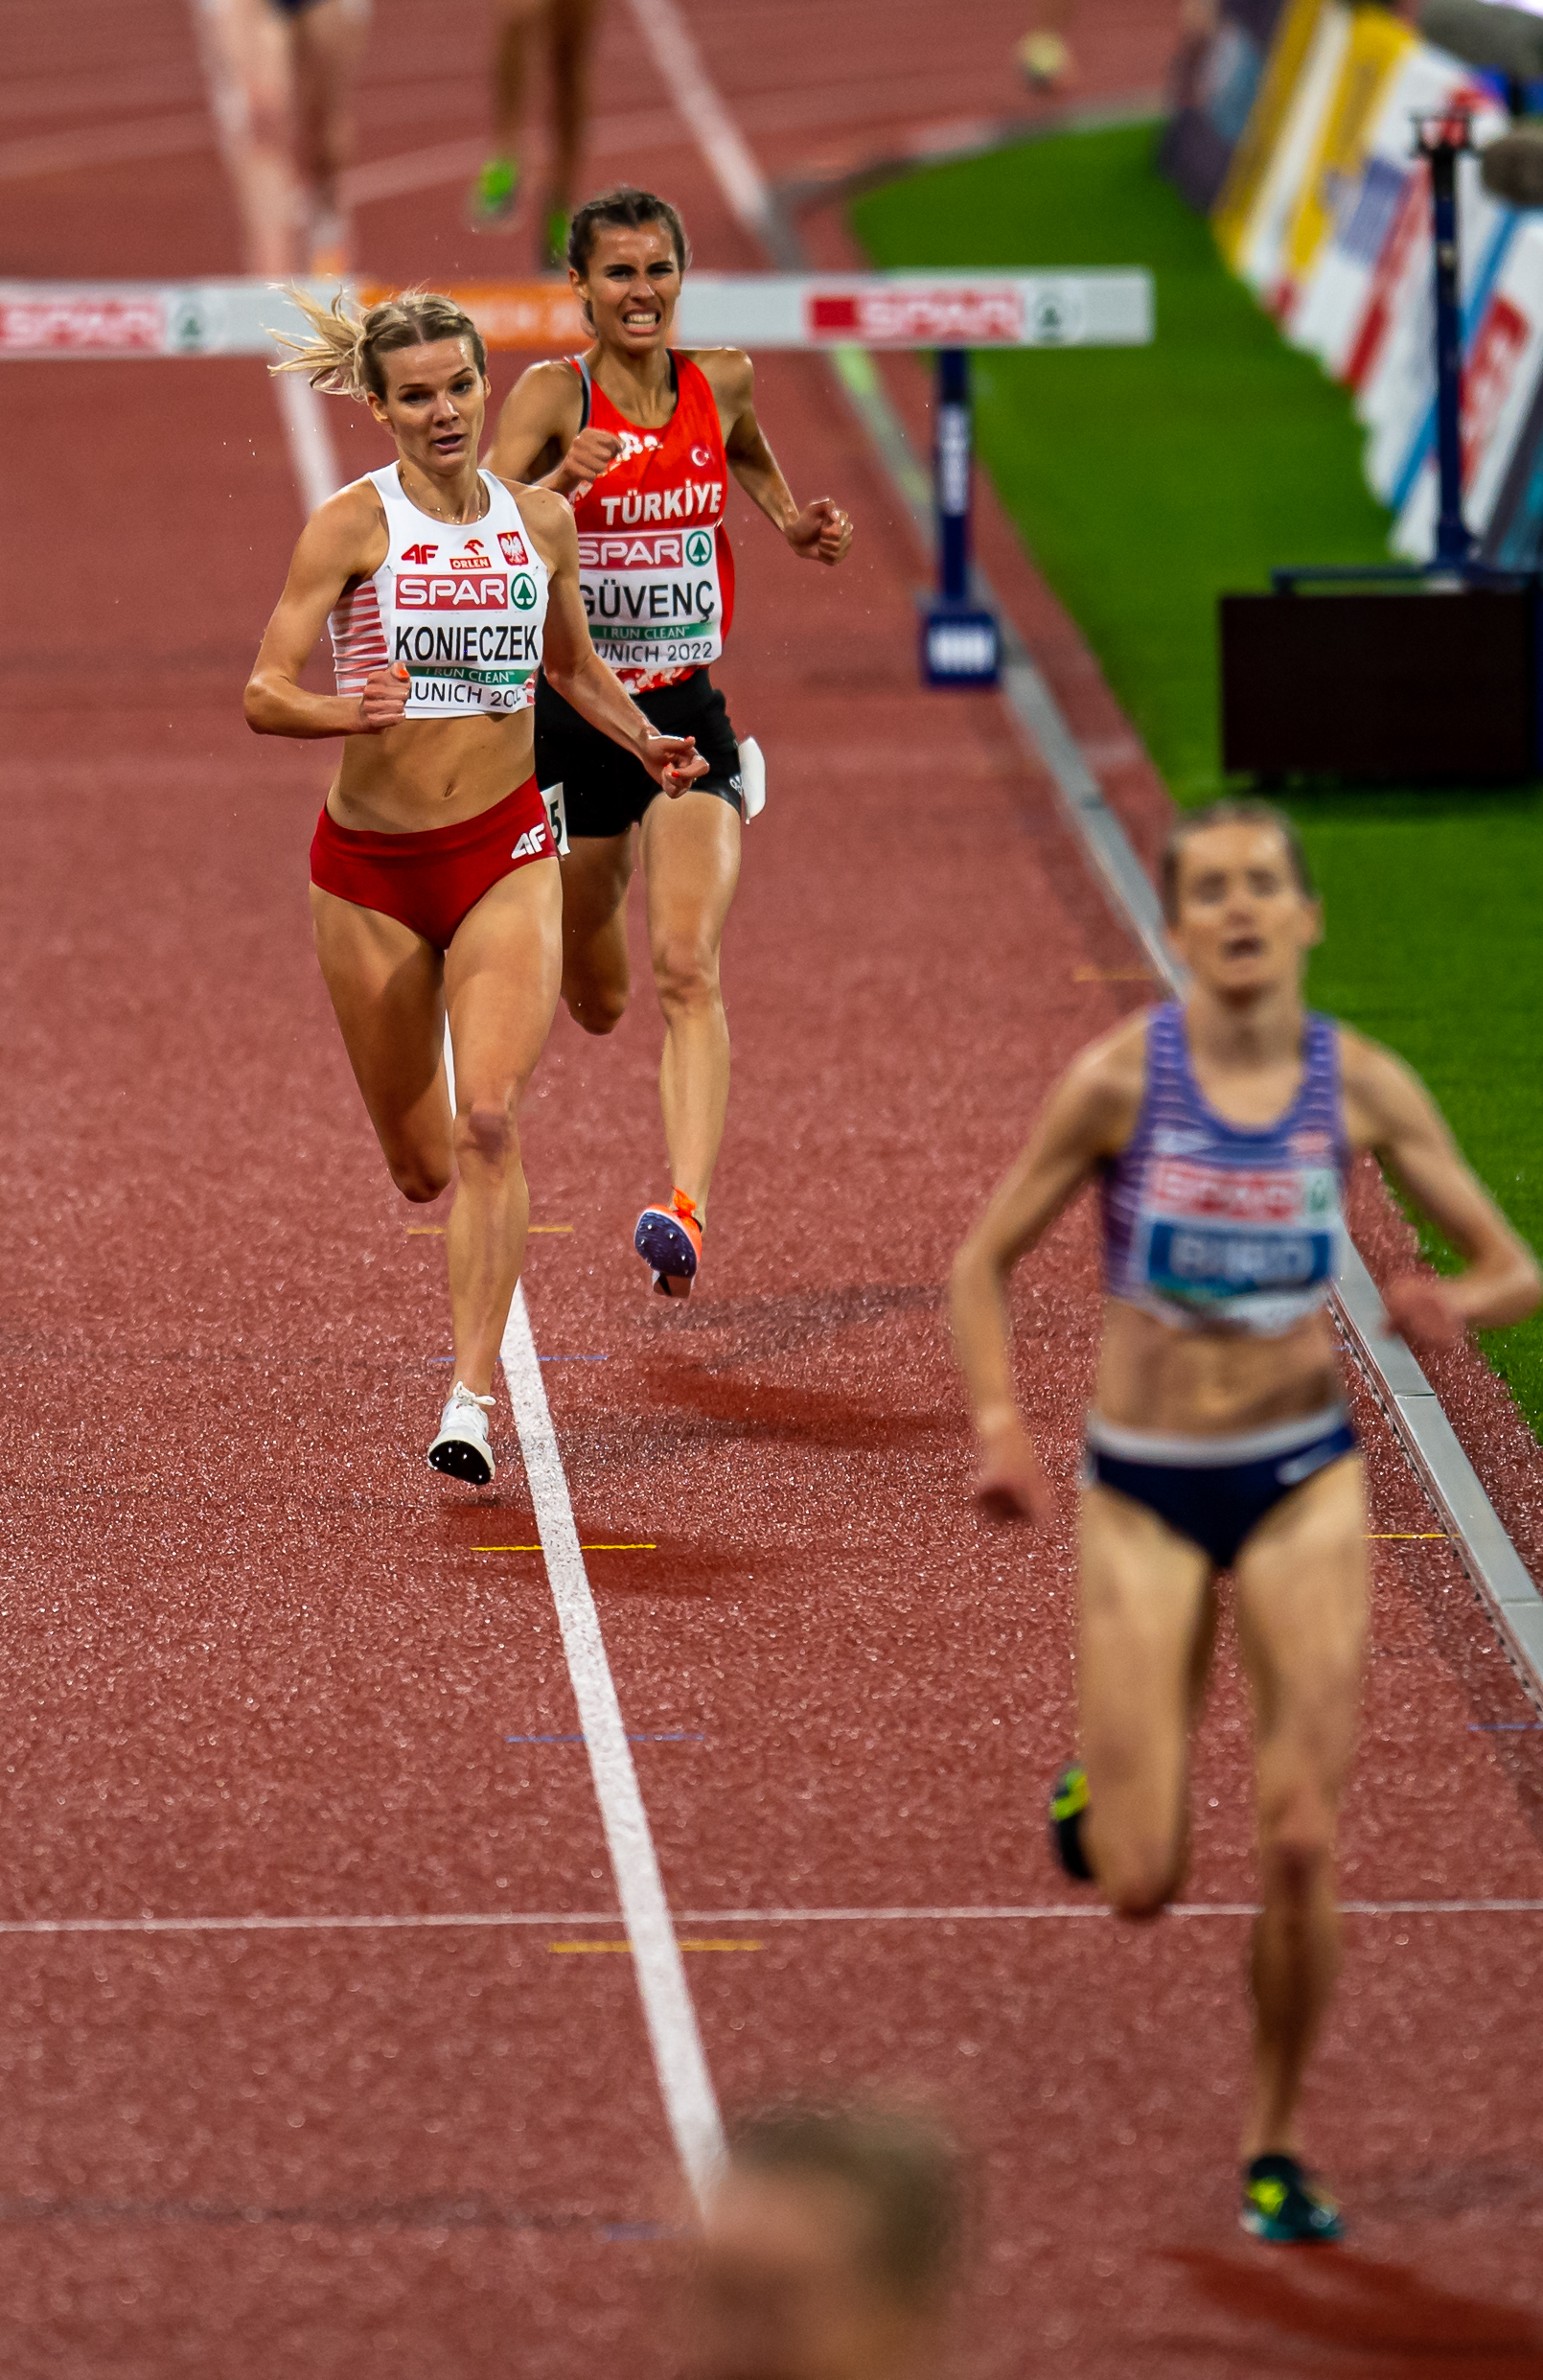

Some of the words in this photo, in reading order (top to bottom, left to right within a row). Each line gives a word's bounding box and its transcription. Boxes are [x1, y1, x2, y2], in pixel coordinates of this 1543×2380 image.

[601, 479, 723, 525] TÜRKİYE
[452, 559, 490, 568] ORLEN
[579, 540, 681, 566] SPAR
[399, 578, 505, 605] SPAR
[579, 579, 715, 624] GÜVENÇ
[395, 625, 539, 661] KONIECZEK
[611, 627, 640, 638] RUN
[593, 641, 659, 662] UNICH
[667, 641, 713, 661] 2022
[434, 668, 465, 678] RUN
[409, 681, 482, 705] UNICH
